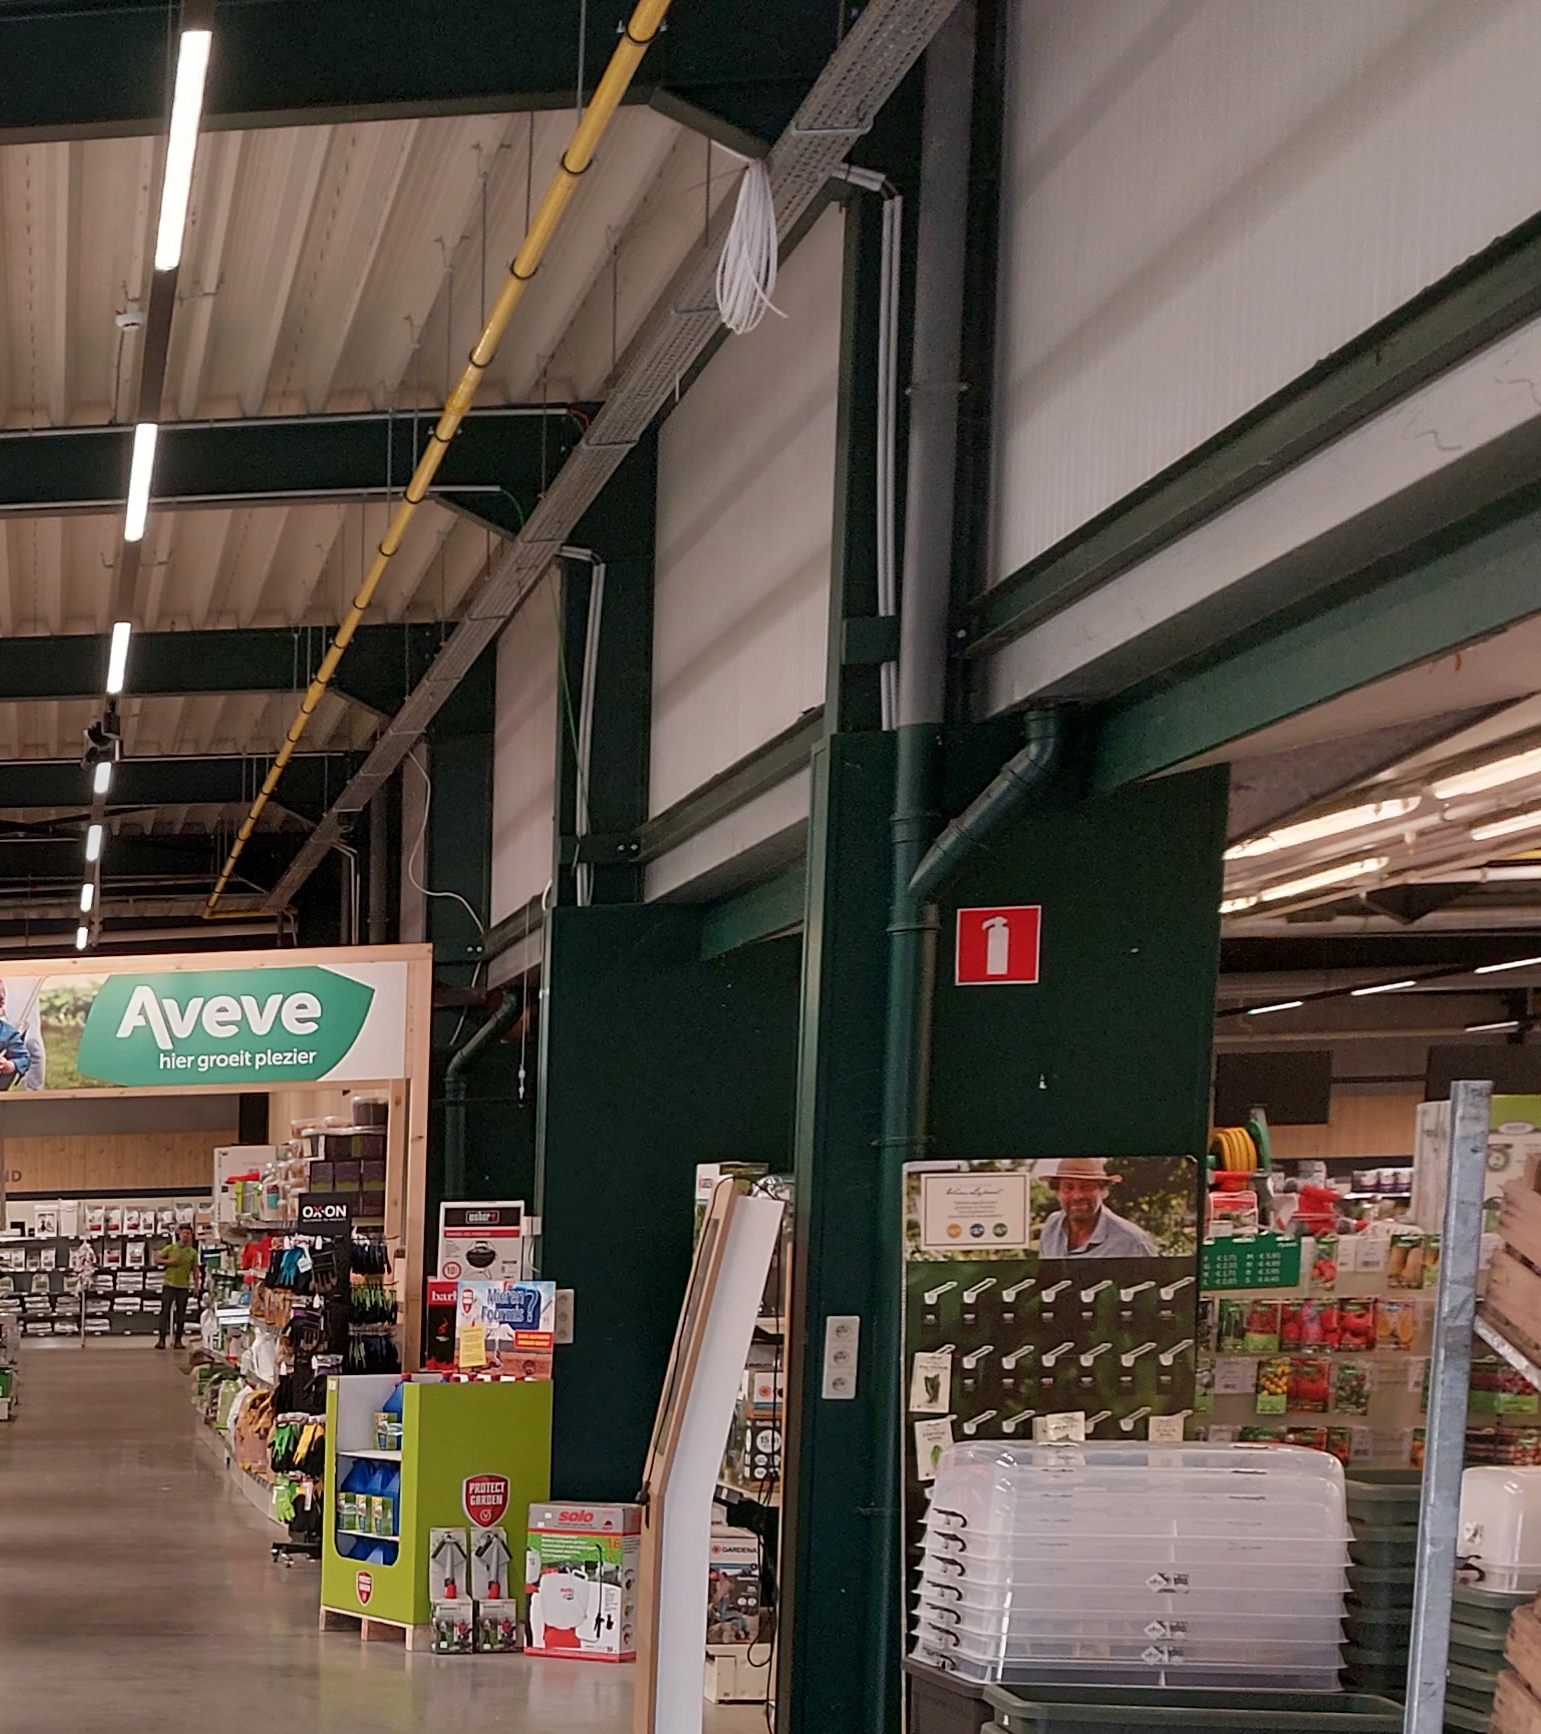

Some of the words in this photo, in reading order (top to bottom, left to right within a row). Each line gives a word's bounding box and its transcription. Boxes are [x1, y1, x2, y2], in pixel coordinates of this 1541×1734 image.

[116, 985, 322, 1049] Aveve
[160, 1052, 195, 1069] hier
[198, 1052, 252, 1072] groeit
[255, 1049, 316, 1069] plezier
[487, 1289, 524, 1304] Mieren
[469, 1482, 505, 1493] PROTECT
[470, 1495, 503, 1505] GARDEN
[558, 1510, 594, 1523] solo
